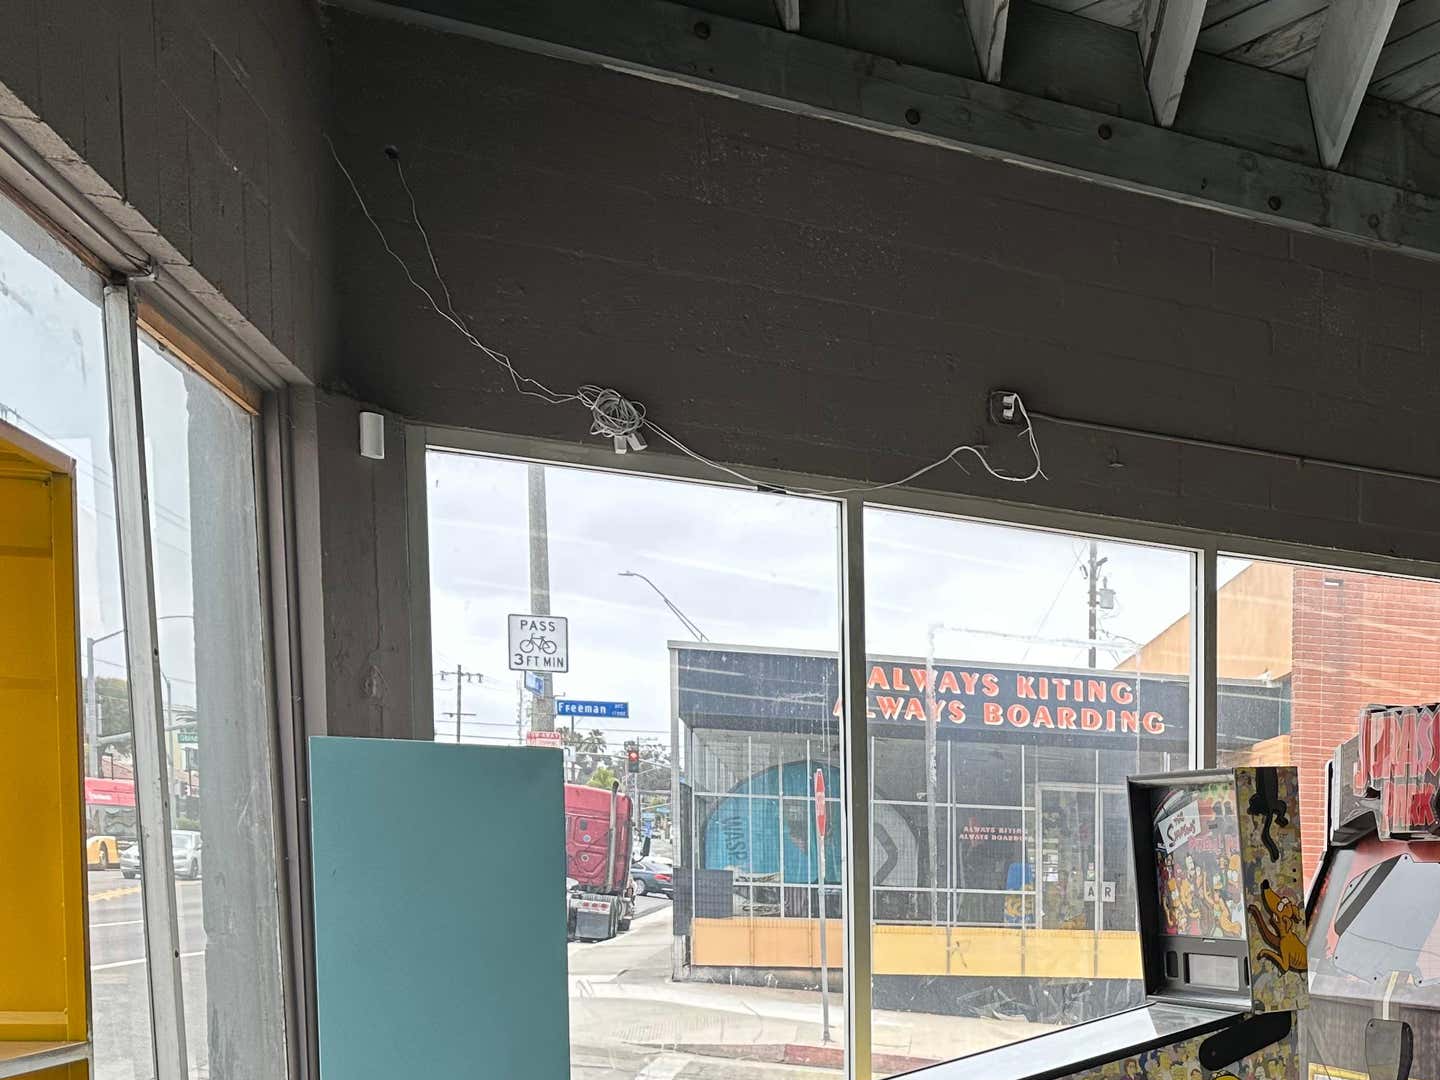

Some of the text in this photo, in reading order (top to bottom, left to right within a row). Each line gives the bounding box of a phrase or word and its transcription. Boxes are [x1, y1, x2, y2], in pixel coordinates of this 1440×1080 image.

[520, 620, 556, 632] PASS
[514, 653, 564, 668] 3 FT MIN
[867, 666, 1135, 704] ALWAYS KITING
[558, 702, 607, 714] Freeman
[983, 702, 1166, 735] BOARDING
[1104, 887, 1111, 897] R
